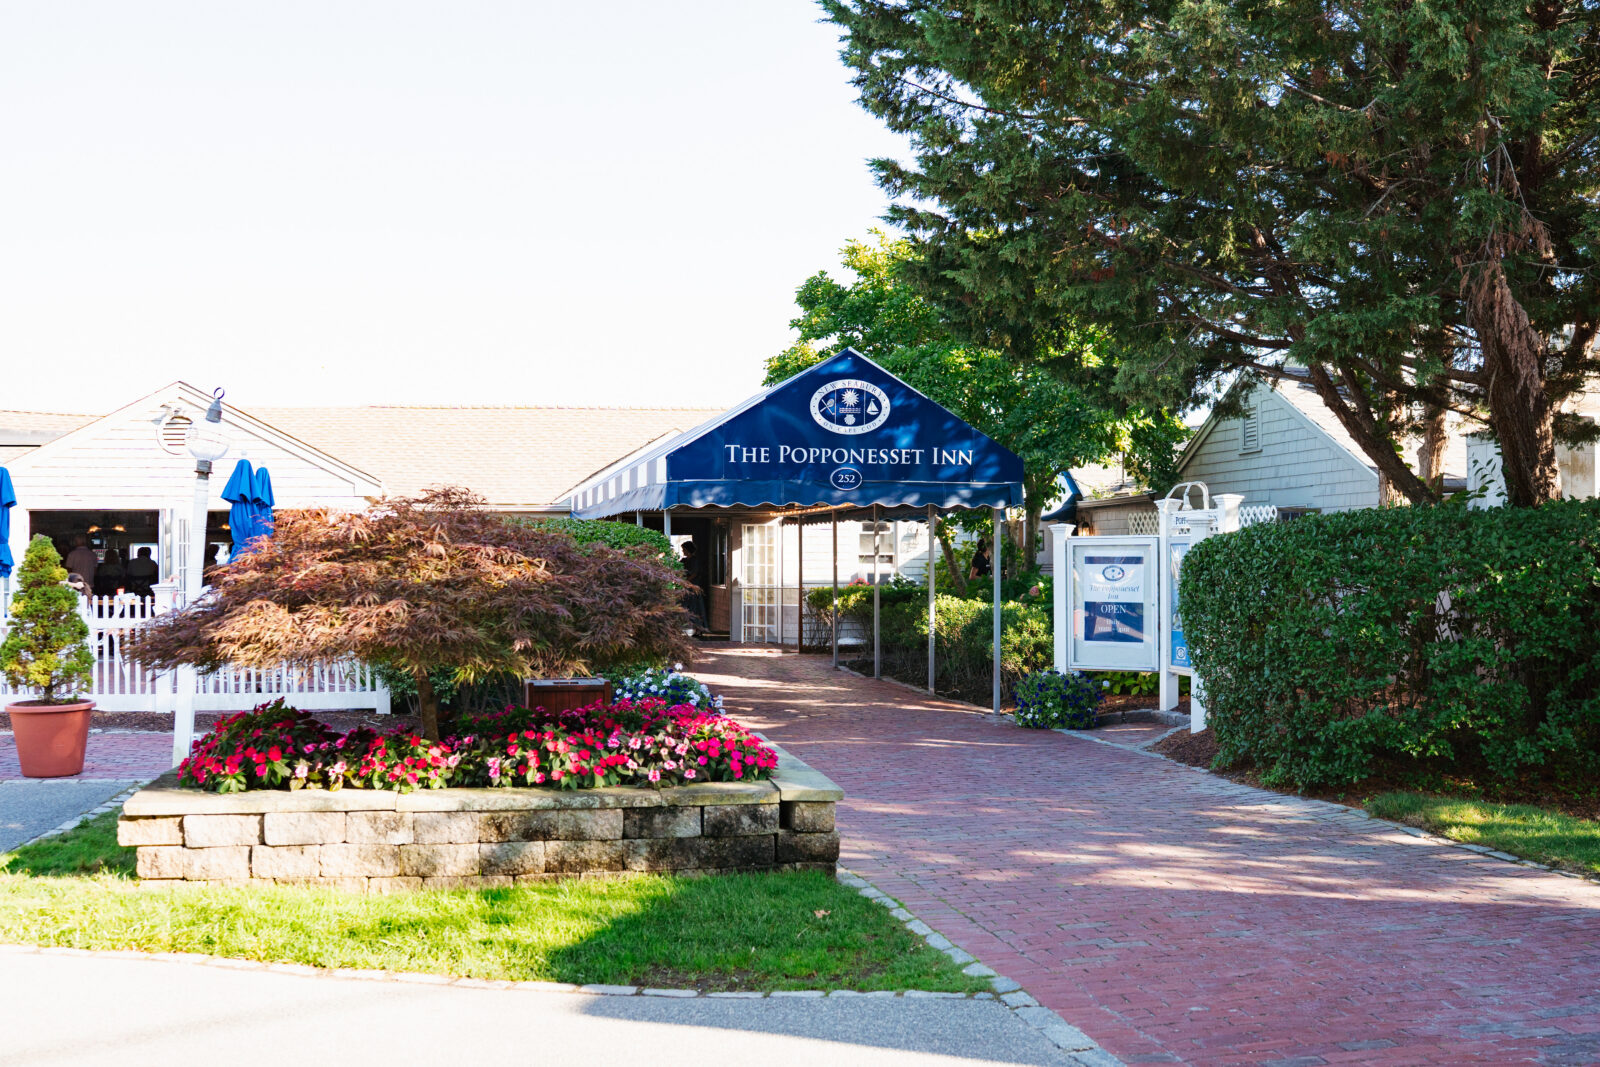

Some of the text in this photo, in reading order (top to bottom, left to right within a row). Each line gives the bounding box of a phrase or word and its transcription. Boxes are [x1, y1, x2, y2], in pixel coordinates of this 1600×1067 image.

[818, 380, 883, 397] NEW SEABURY
[823, 421, 834, 430] ON
[861, 422, 877, 432] COD
[725, 444, 974, 466] THE POPPONESSET INN
[837, 474, 856, 483] 252
[1100, 604, 1127, 614] OPEN
